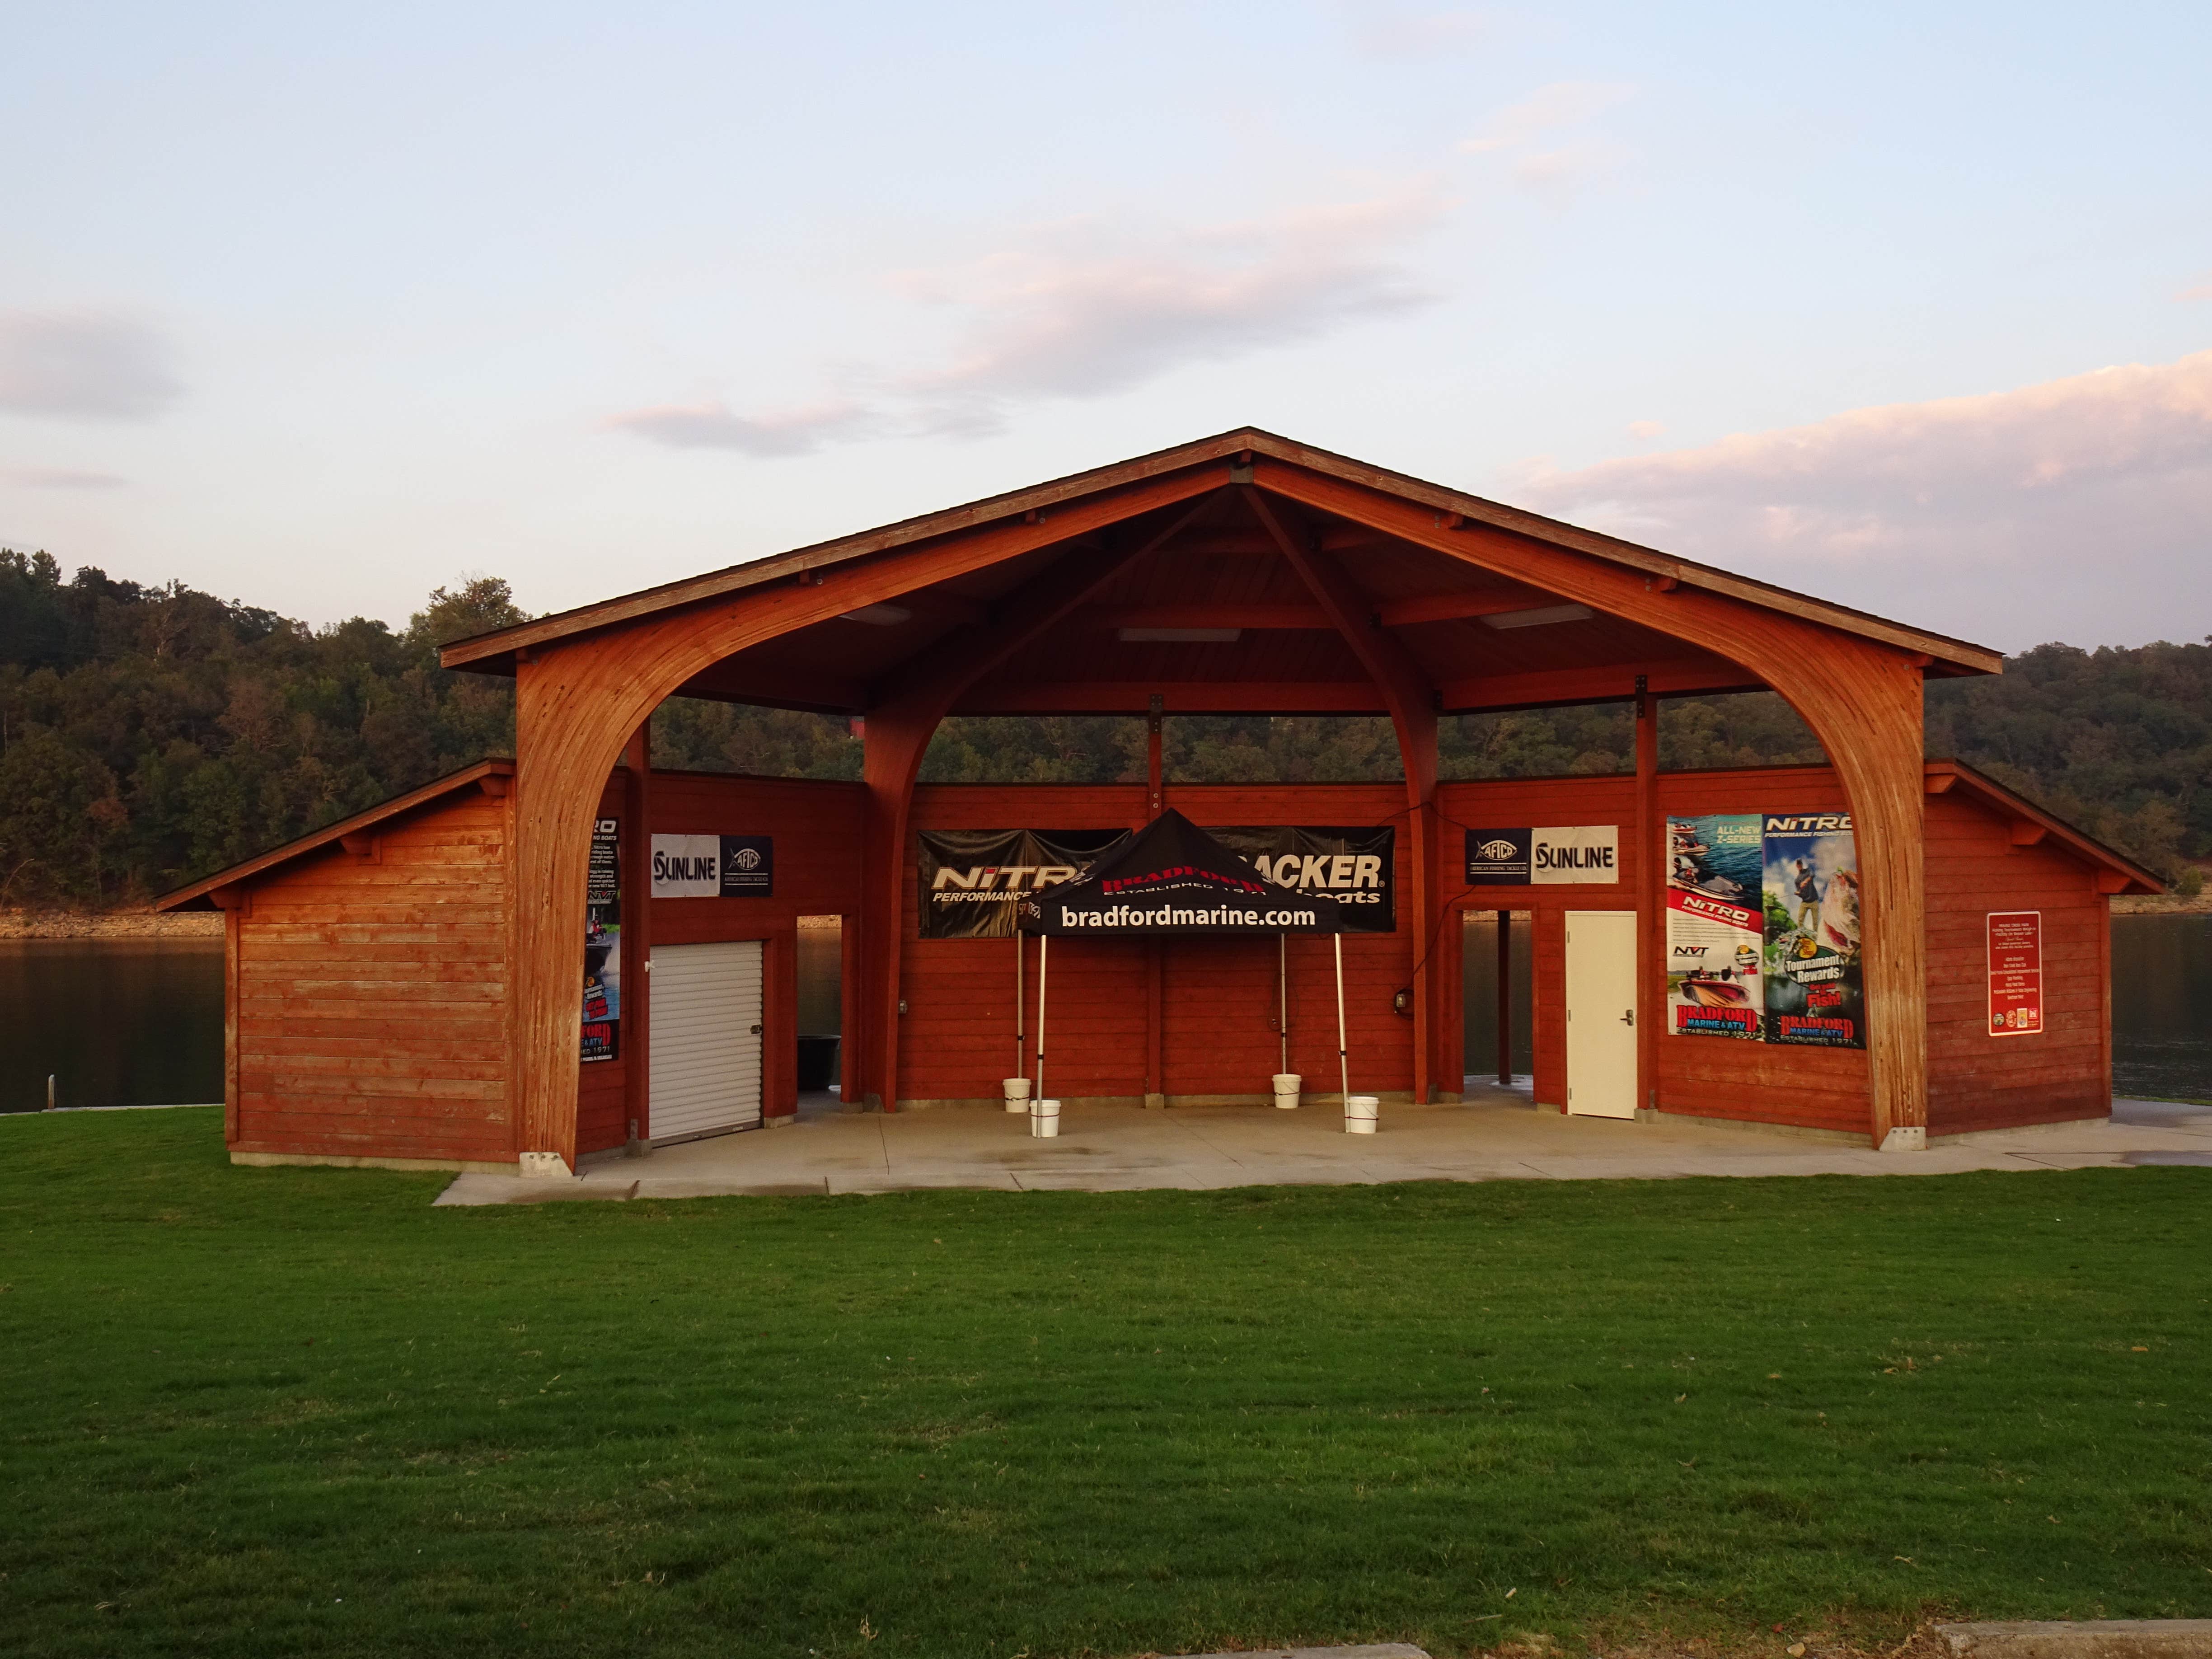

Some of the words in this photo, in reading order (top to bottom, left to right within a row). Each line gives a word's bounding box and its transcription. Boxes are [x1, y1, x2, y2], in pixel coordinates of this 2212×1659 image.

[1717, 826, 1761, 834] ALL-NEW
[1717, 835, 1761, 843] Z-SERIES
[1484, 842, 1513, 859] AFTCO
[1536, 842, 1613, 868] SUNLINE
[654, 850, 716, 881] SUNLINE
[737, 851, 758, 868] AFTCO
[1104, 882, 1213, 895] ESTABLISHED
[1062, 904, 1315, 927] bradfordmarine.com
[1674, 946, 1709, 955] NVT
[1786, 954, 1840, 971] Tournament
[1797, 967, 1840, 983] Rewards
[1807, 991, 1841, 1008] Fish!
[1677, 1005, 1757, 1032] BRADFORD
[1687, 1019, 1720, 1028] MARINE
[1727, 1022, 1745, 1030] ATV
[1781, 1016, 1854, 1038] BRADFORD
[1677, 1027, 1729, 1036] ESTABLISHED
[1790, 1027, 1820, 1036] MARINE
